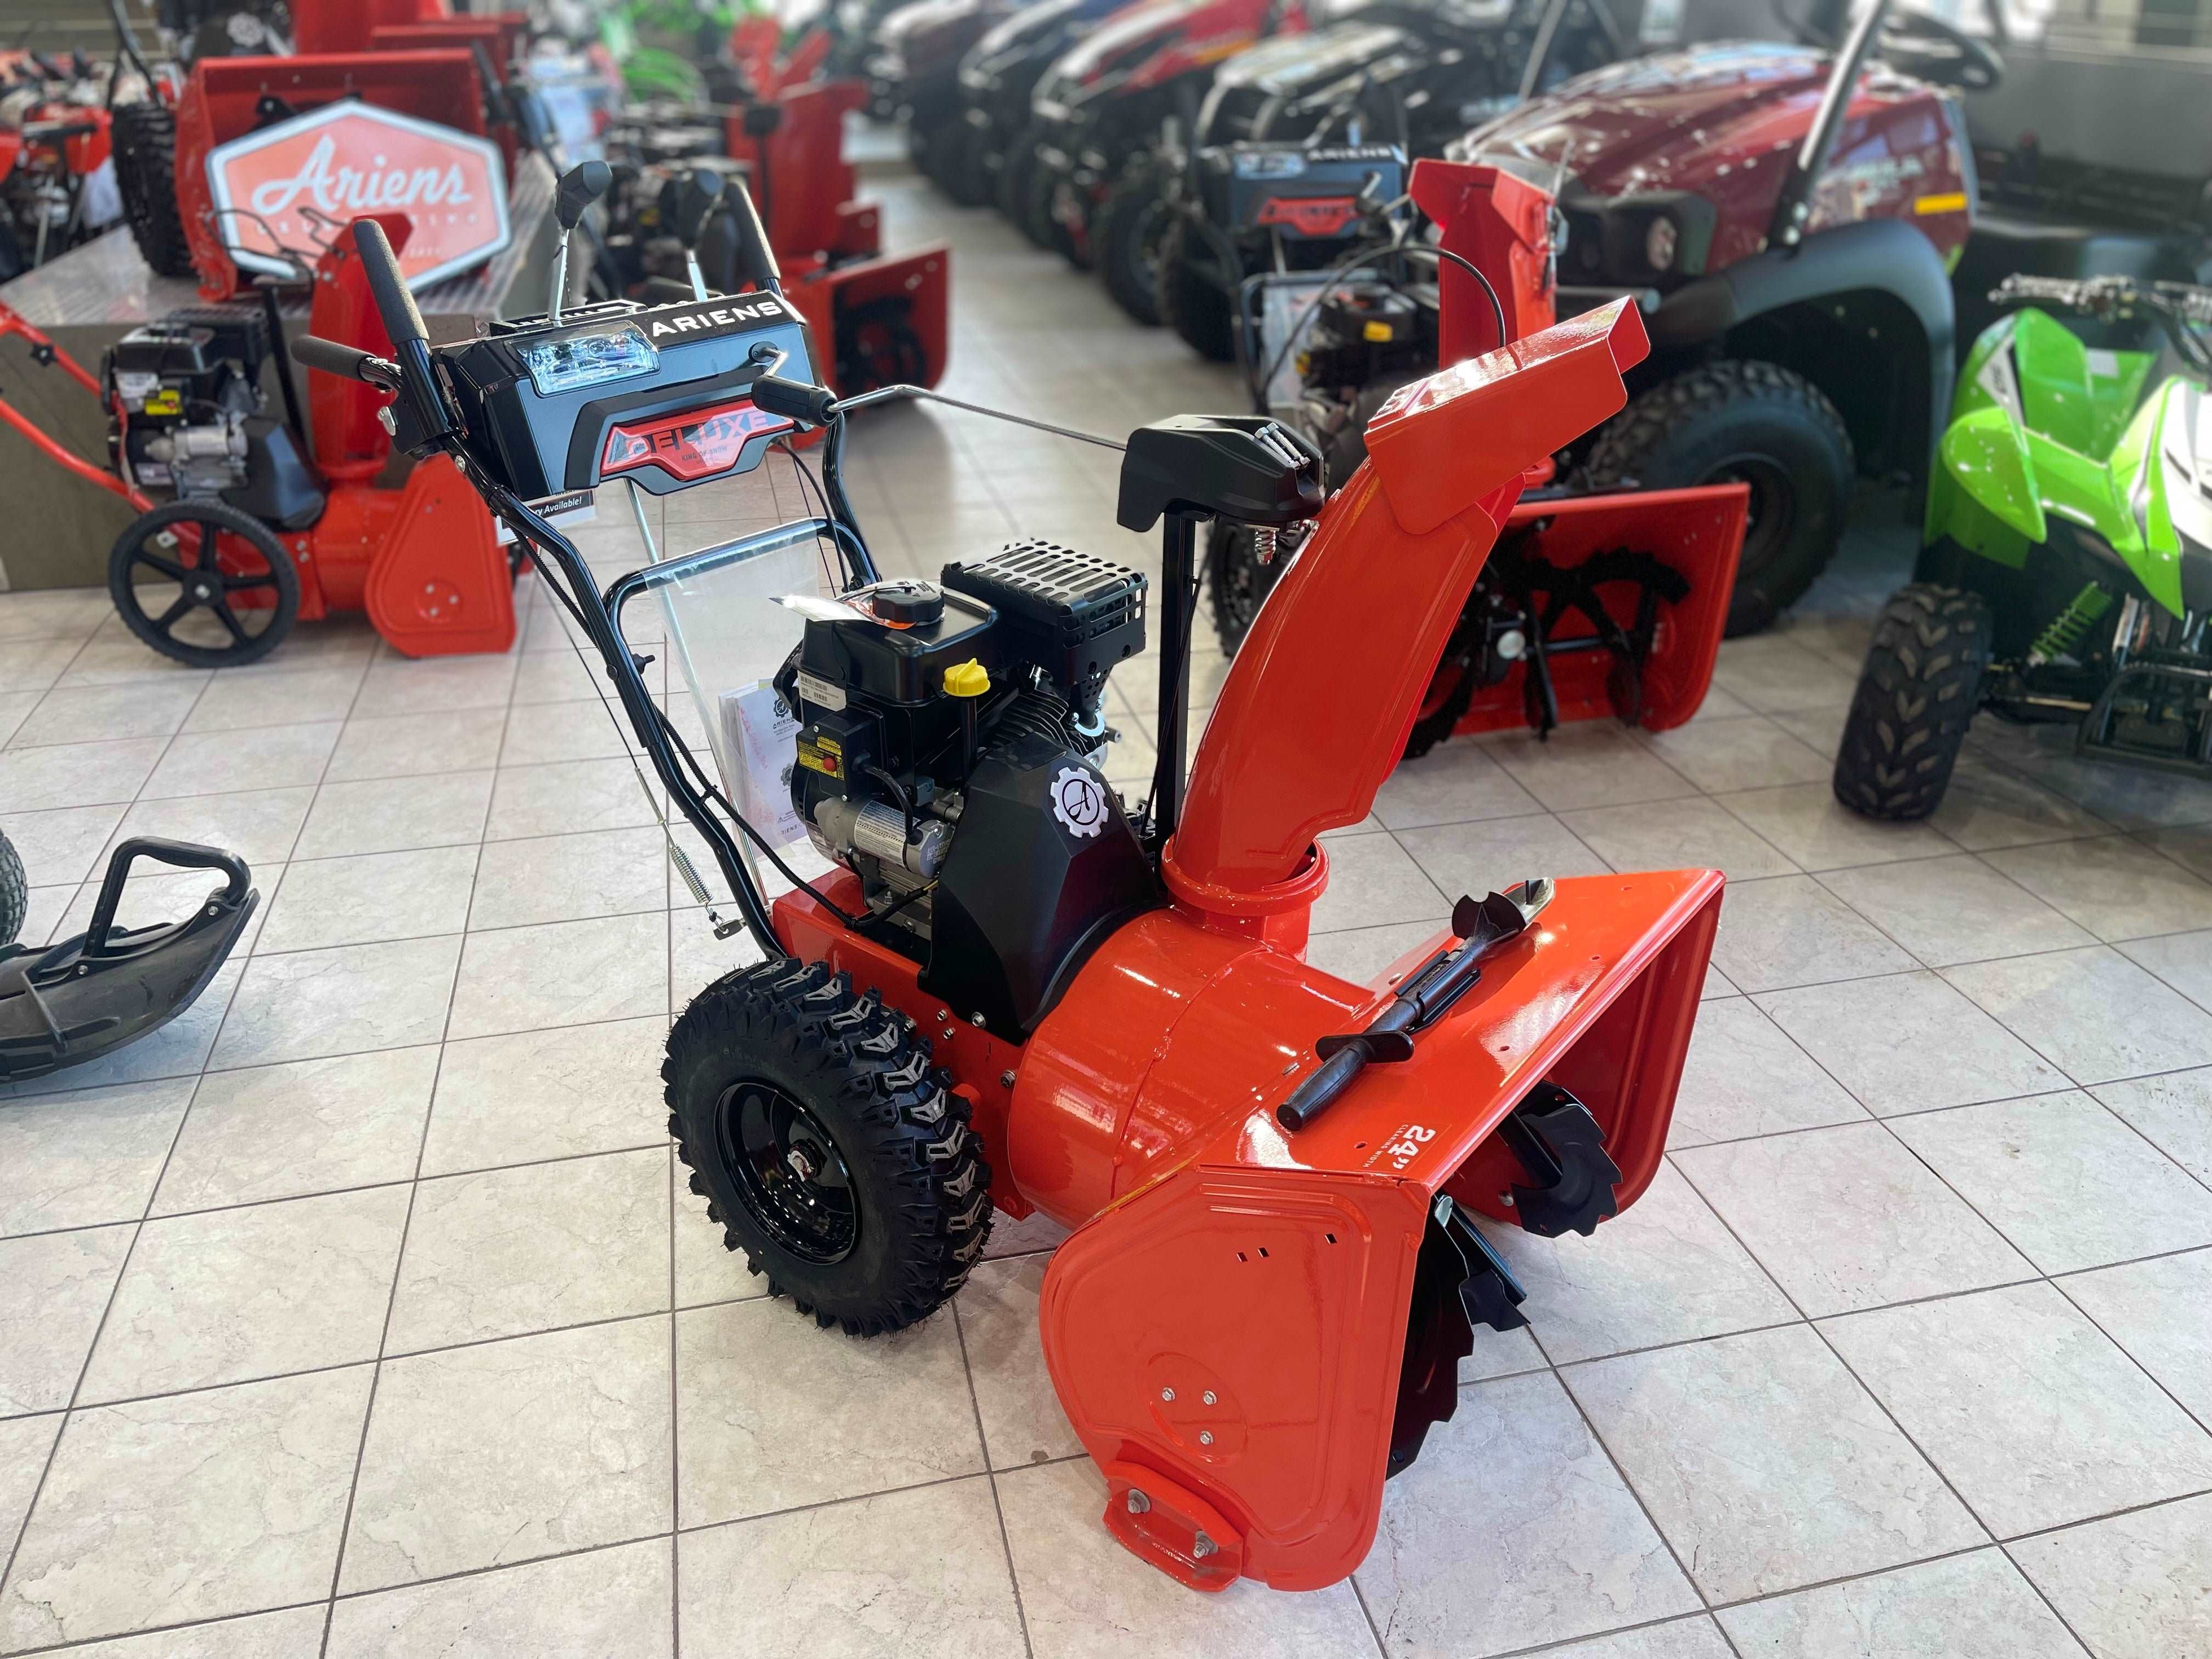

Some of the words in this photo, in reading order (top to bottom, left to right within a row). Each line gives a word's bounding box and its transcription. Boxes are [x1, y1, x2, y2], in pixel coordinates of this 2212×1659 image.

[251, 134, 471, 215] Ariens
[653, 302, 782, 337] ARIENS
[682, 452, 697, 461] KING
[544, 496, 582, 514] Available!
[1380, 1124, 1409, 1149] CLEARING
[1363, 1150, 1384, 1167] WIDTH
